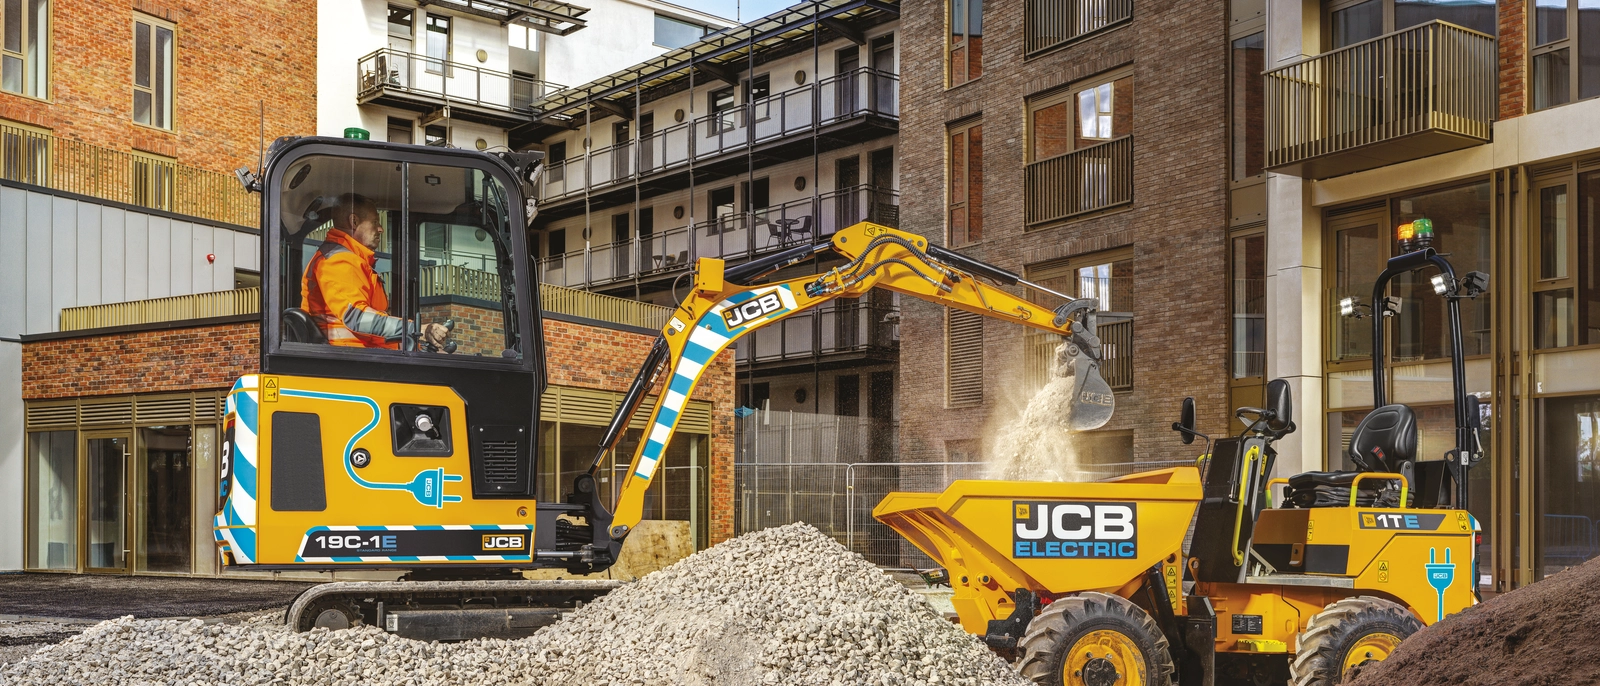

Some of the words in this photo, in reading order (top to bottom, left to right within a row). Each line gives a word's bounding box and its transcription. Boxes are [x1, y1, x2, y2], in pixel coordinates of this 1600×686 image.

[728, 293, 781, 327] JCB
[1015, 504, 1135, 540] JCB
[1377, 514, 1420, 529] 1TE
[315, 535, 397, 549] 19C-1E
[484, 536, 522, 548] JCB
[1015, 541, 1135, 557] ELECTRIC
